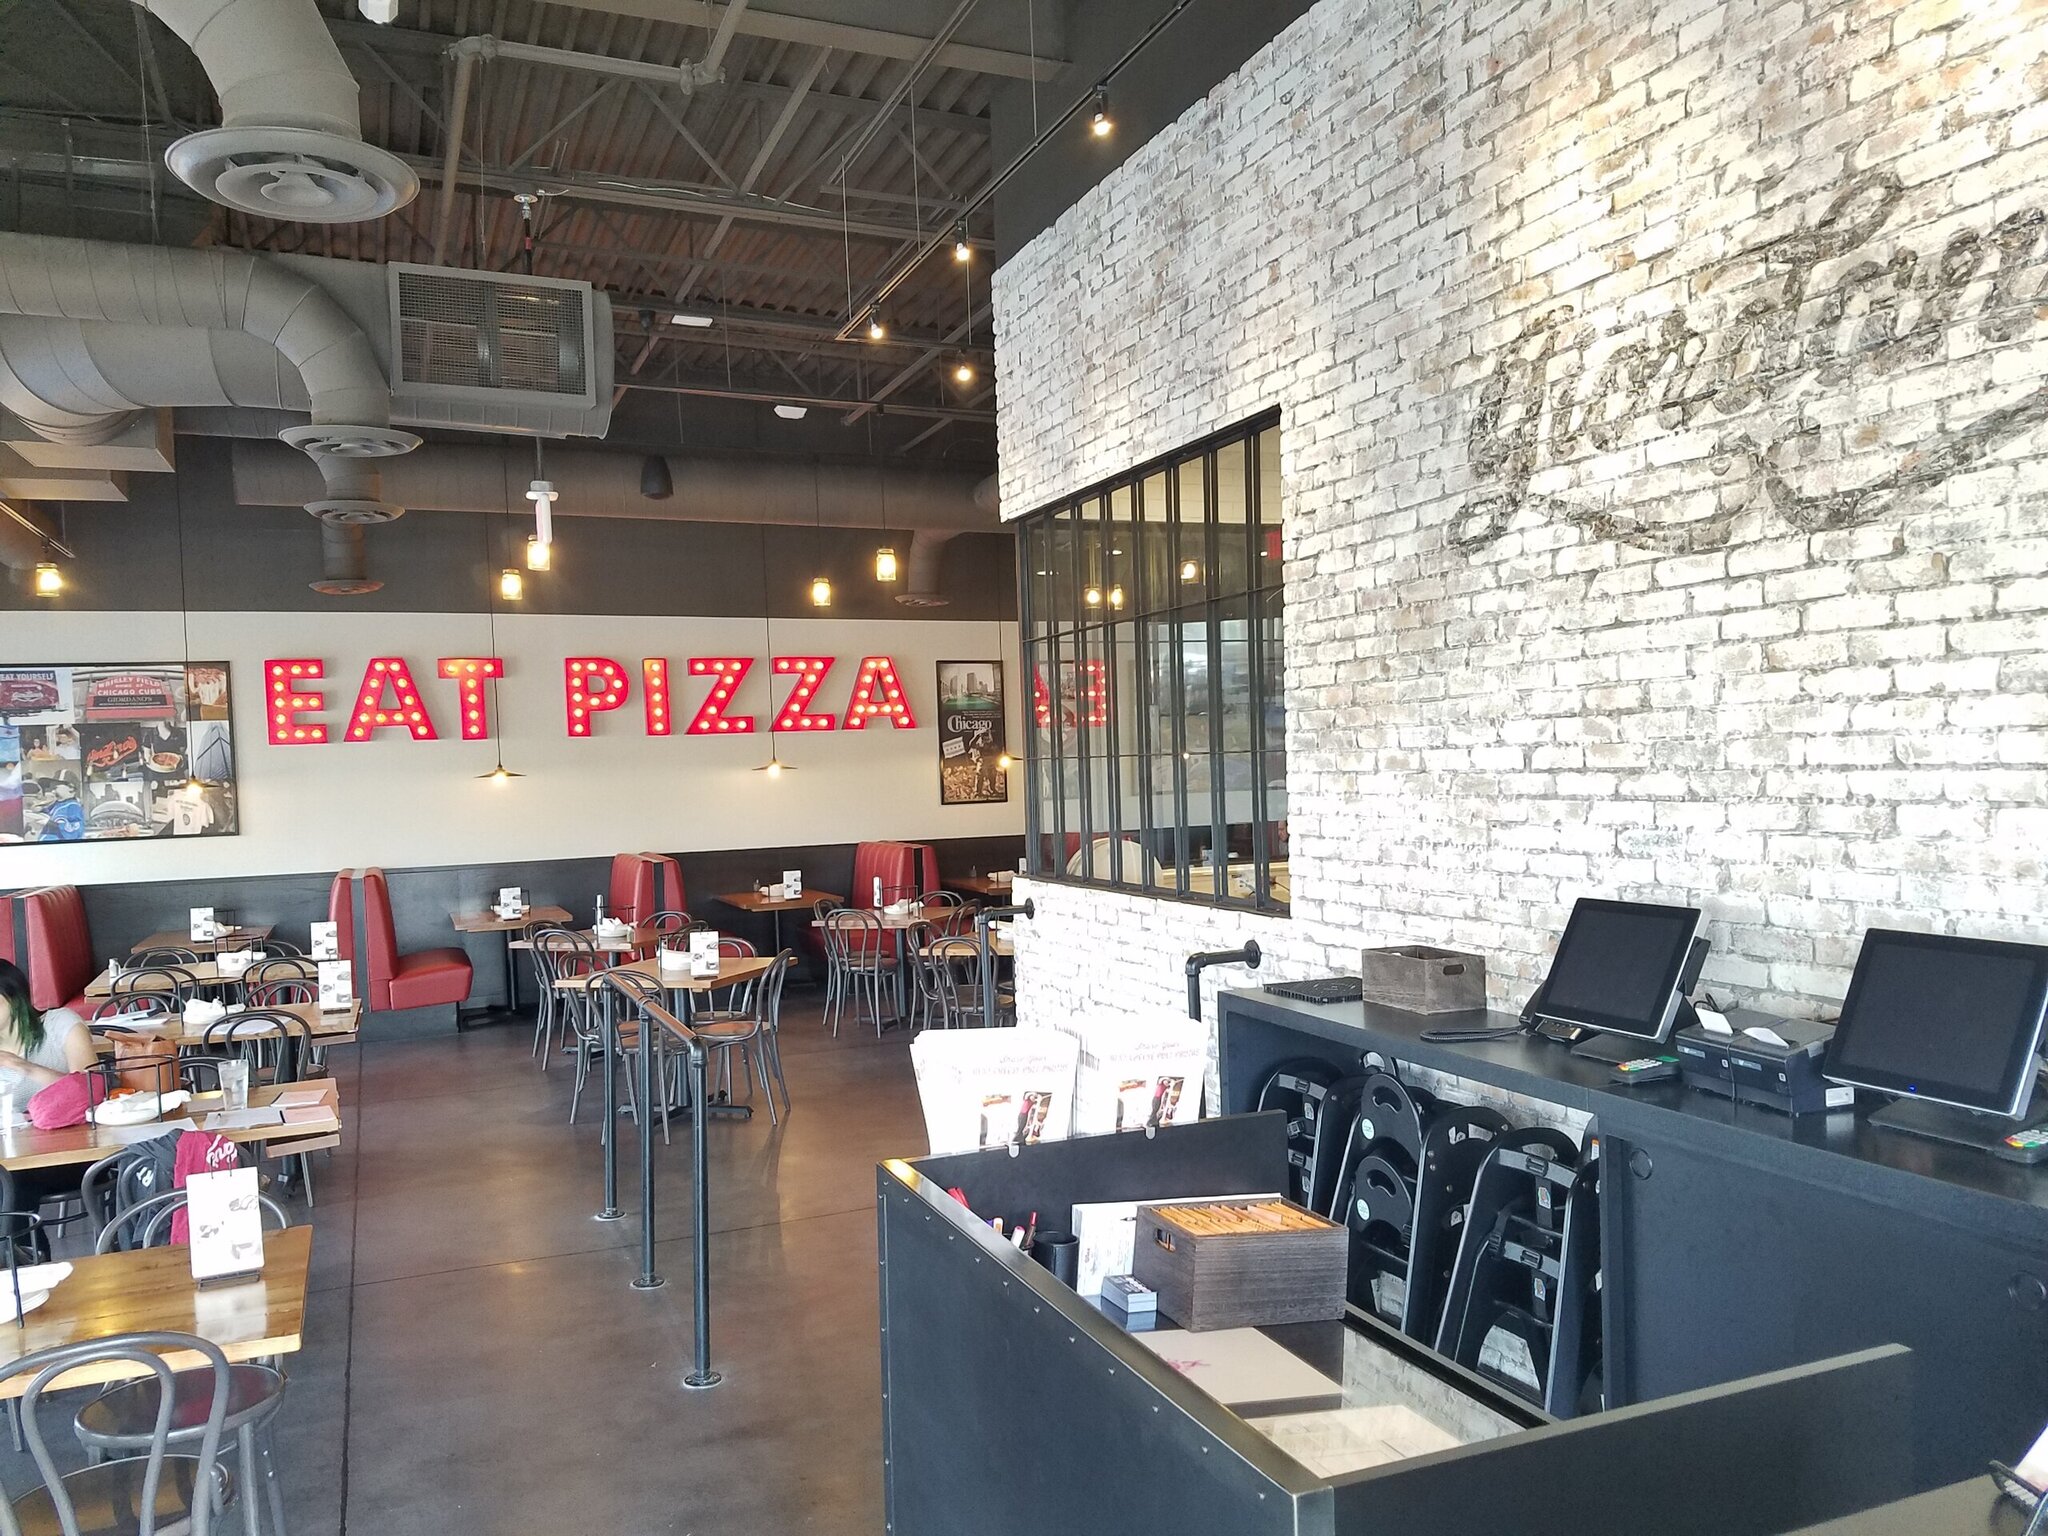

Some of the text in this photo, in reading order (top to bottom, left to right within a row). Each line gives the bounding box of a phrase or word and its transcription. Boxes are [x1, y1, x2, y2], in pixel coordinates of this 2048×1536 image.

[136, 676, 160, 687] FIELD
[264, 656, 917, 746] EAT PIZZA
[947, 714, 993, 733] Chicago
